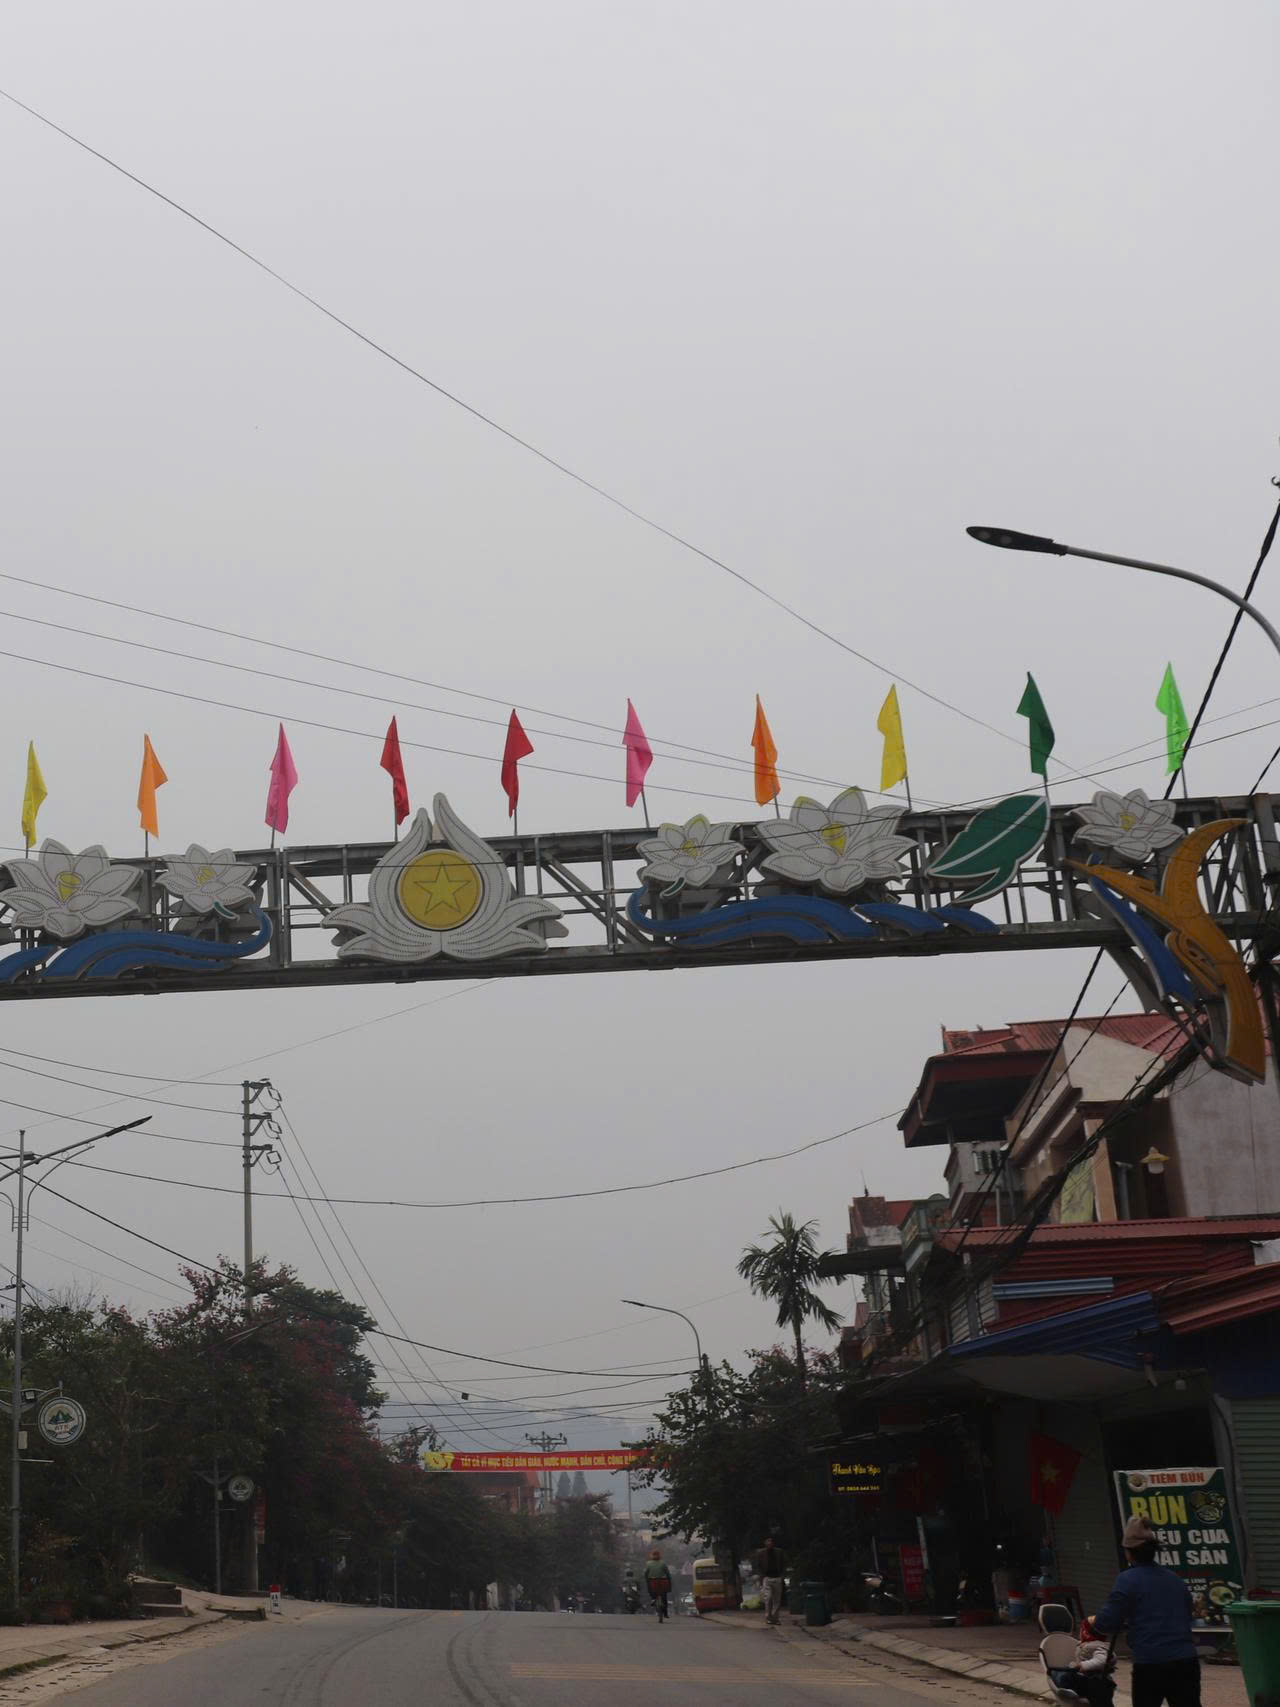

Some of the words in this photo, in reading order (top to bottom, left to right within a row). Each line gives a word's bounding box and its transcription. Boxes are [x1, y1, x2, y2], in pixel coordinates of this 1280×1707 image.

[1129, 1491, 1188, 1525] BÚN
[1188, 1528, 1231, 1545] CUA
[1186, 1546, 1228, 1566] SẢN
